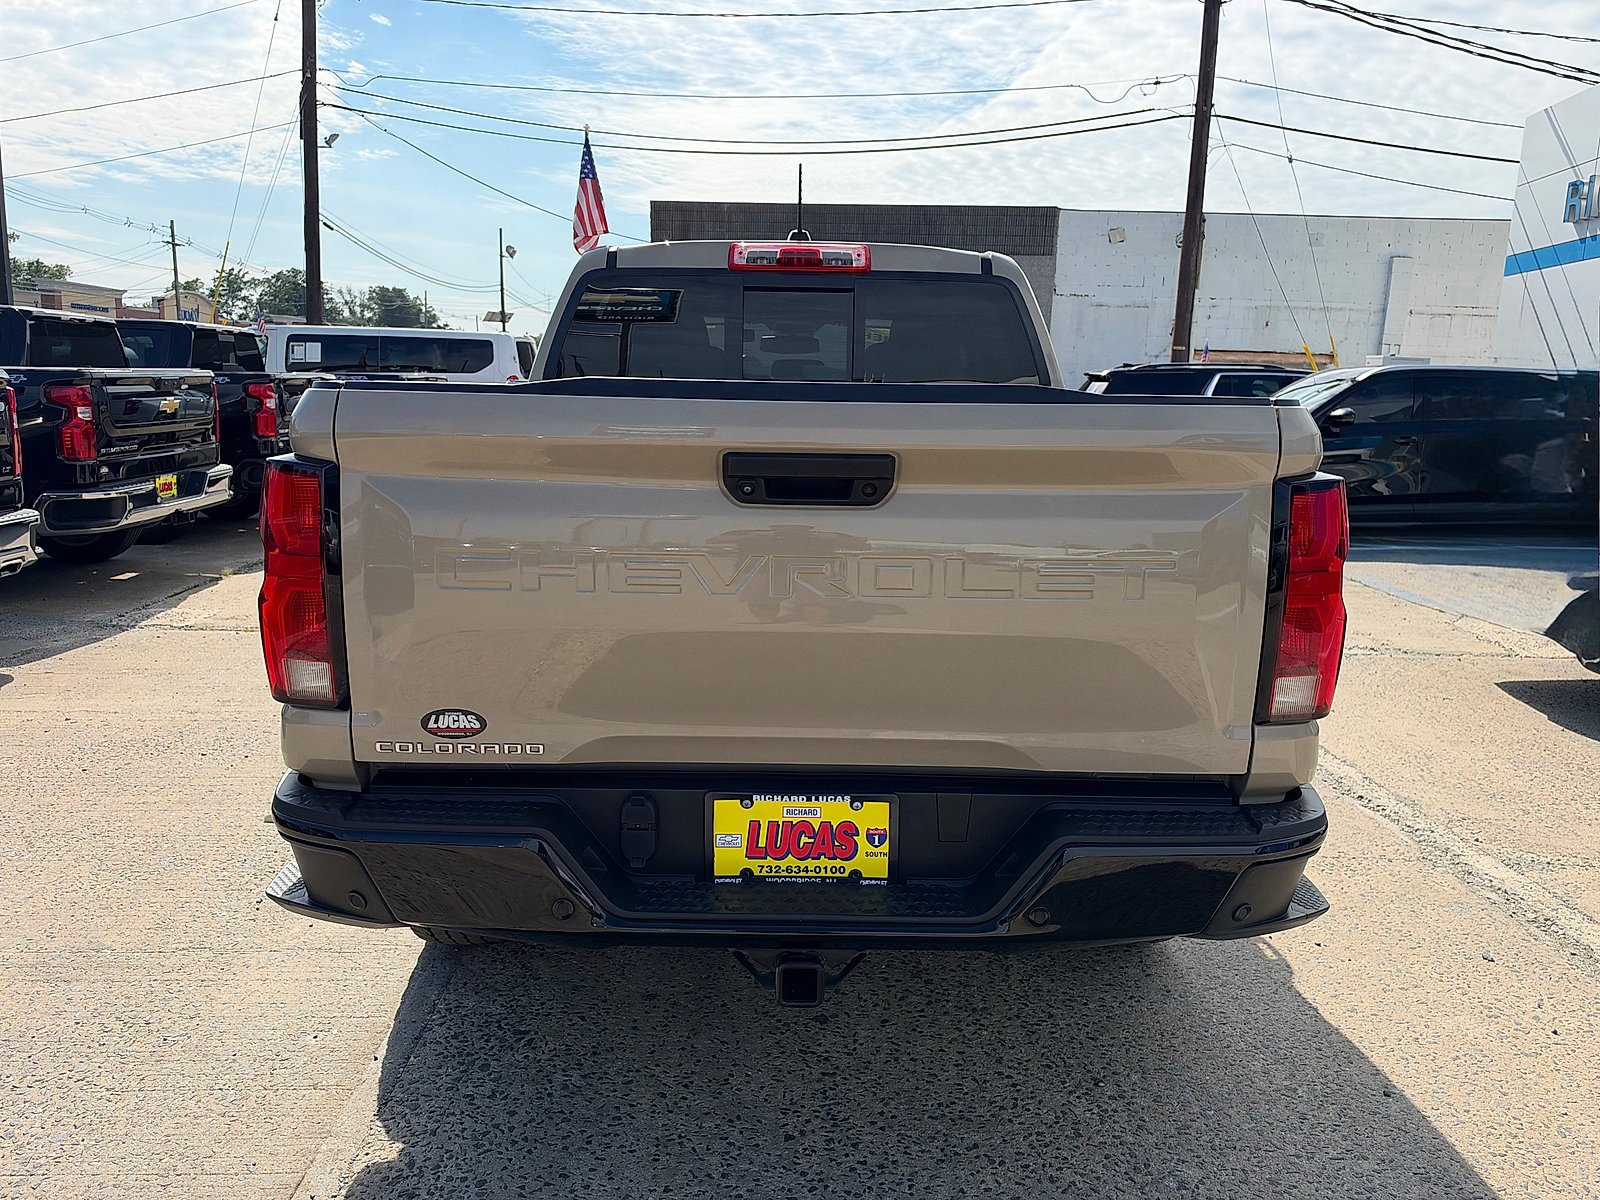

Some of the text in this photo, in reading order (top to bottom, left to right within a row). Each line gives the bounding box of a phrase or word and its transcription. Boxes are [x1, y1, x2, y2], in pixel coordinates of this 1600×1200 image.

[434, 550, 1176, 600] CHEVROLET
[427, 714, 481, 729] LUCAS
[375, 740, 545, 756] COLORADO
[752, 794, 851, 803] RICHARD LUCAS
[785, 808, 818, 817] RICHARD
[745, 820, 860, 861] LUCAS
[872, 834, 881, 846] 1
[757, 865, 846, 875] 732-634-0100
